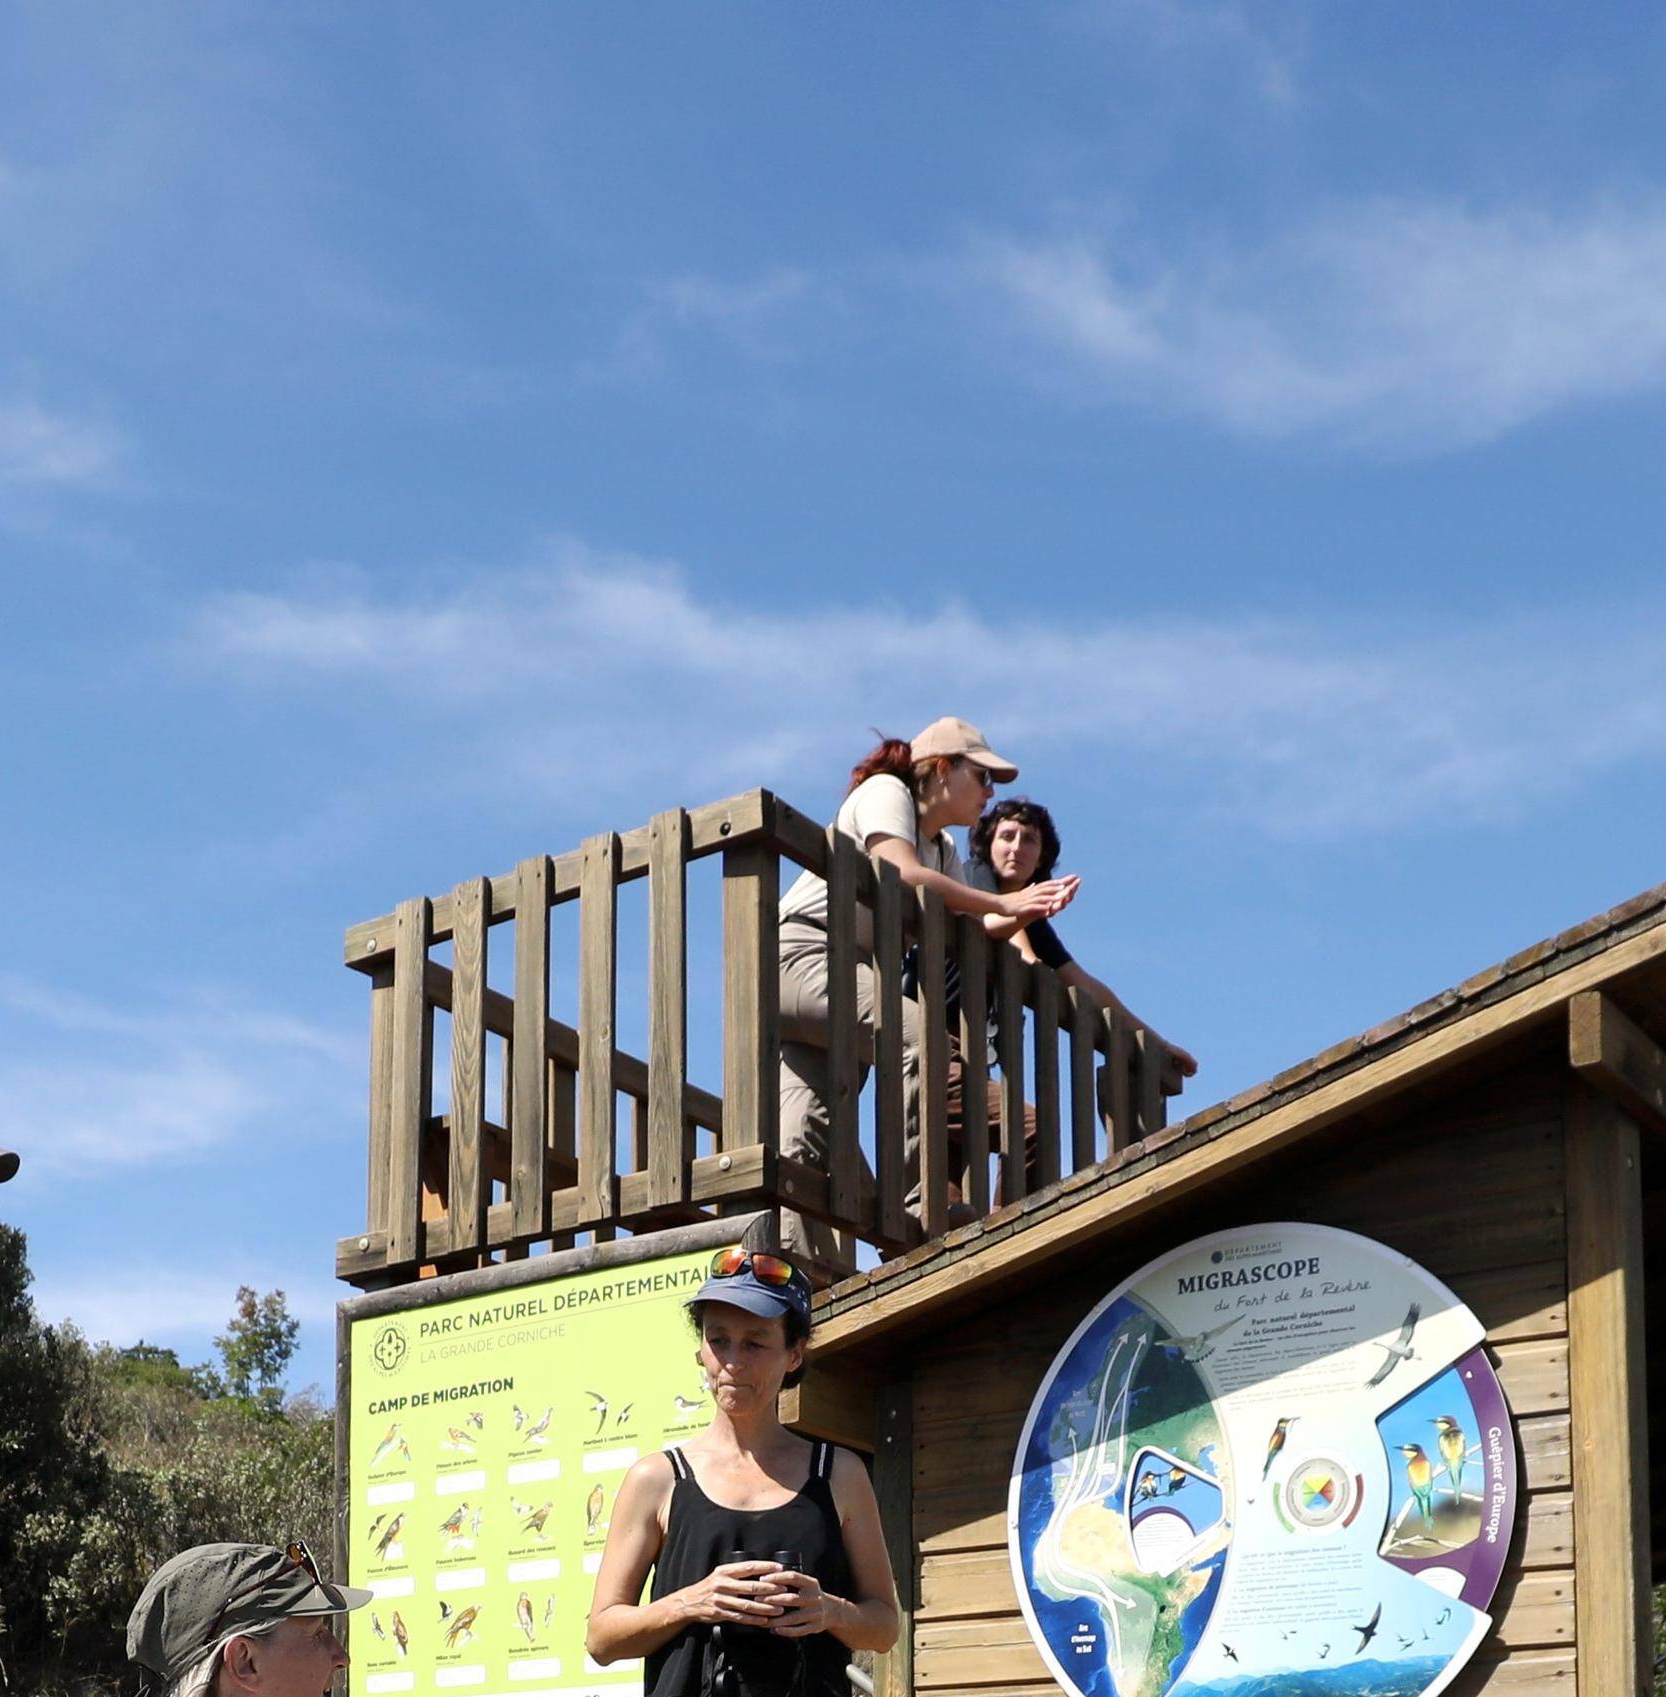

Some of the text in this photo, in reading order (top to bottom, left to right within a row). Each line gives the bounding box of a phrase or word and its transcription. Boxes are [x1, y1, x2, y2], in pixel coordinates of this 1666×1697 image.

[1177, 1257, 1321, 1295] MIGRASCOPE
[1214, 1298, 1230, 1312] du
[1236, 1293, 1267, 1307] Fort
[1274, 1289, 1292, 1303] de
[1300, 1287, 1313, 1299] la
[420, 1315, 463, 1338] PARC
[469, 1300, 548, 1328] NATUREL
[420, 1323, 567, 1363] LA GRANDE CORNICHE
[368, 1377, 514, 1415] CAMP DE MIGRATION
[1487, 1427, 1507, 1544] Guêpier d'Europe
